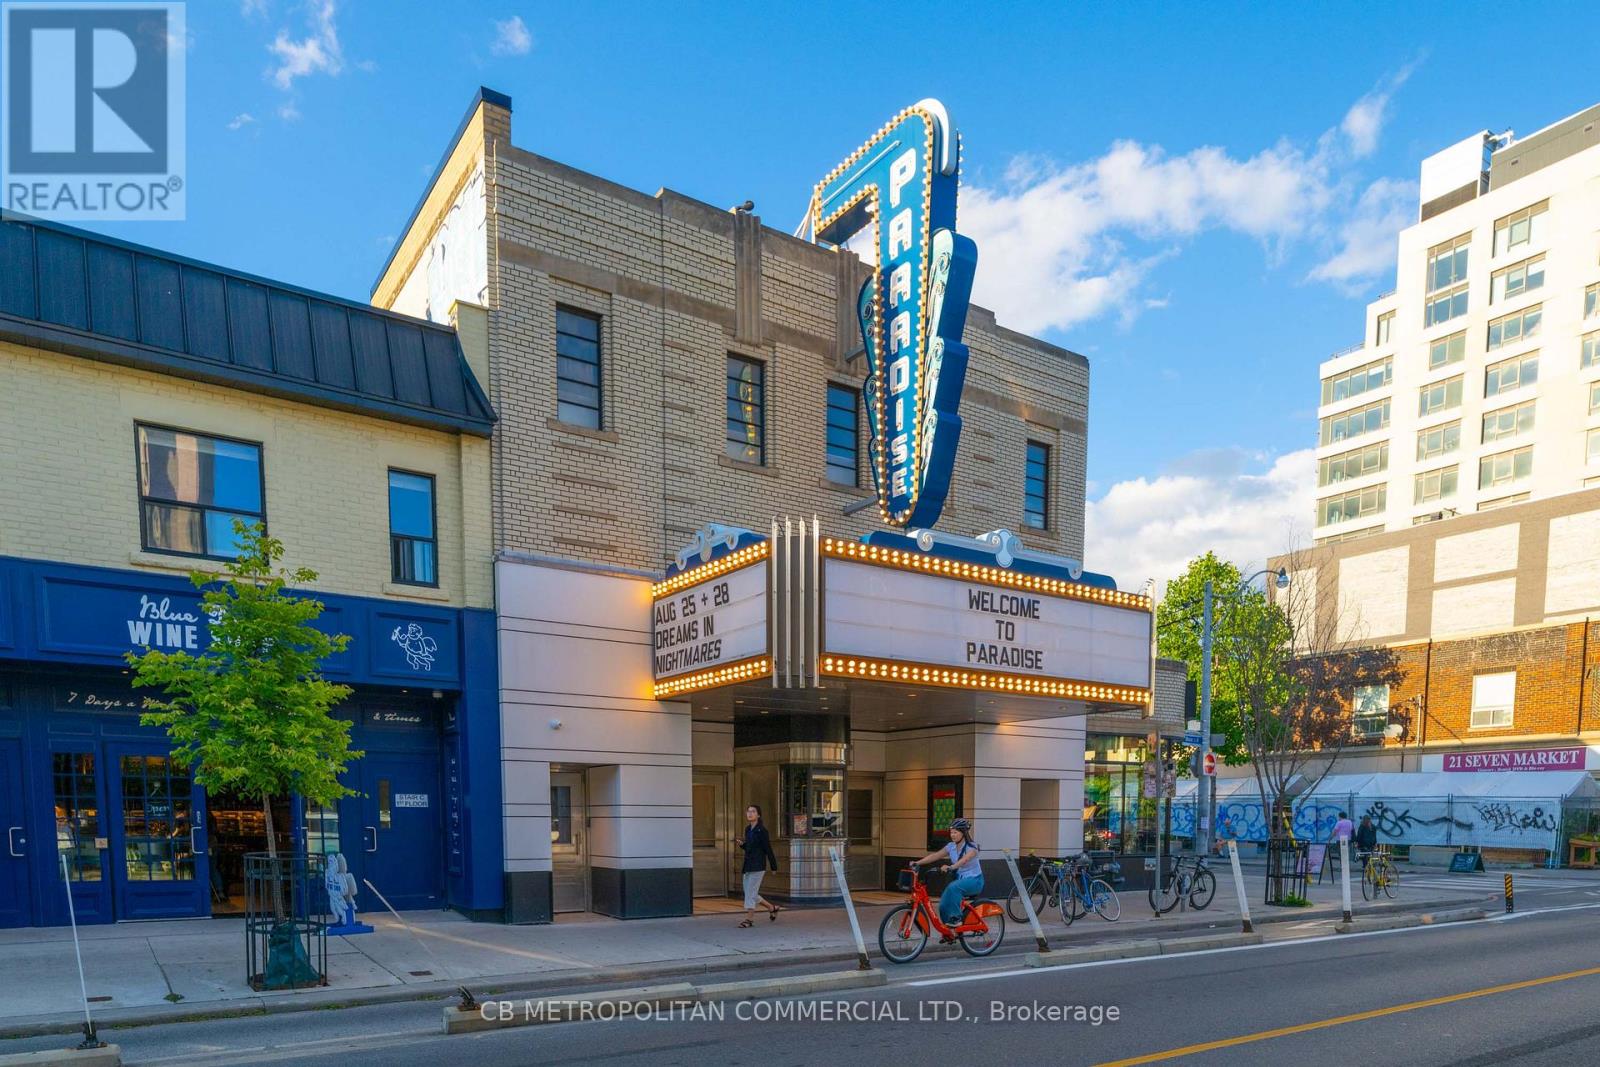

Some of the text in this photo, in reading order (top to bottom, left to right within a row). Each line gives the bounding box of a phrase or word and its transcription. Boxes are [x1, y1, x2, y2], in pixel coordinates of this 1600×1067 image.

[889, 148, 917, 498] PARADISE
[139, 594, 199, 623] Blue
[655, 582, 730, 626] AUG 25 + 28
[968, 588, 1040, 619] WELCOME
[127, 620, 198, 649] WINE
[655, 614, 714, 650] DREAMS IN
[995, 619, 1015, 641] TO
[655, 639, 722, 674] NIGHTMARES
[966, 641, 1043, 670] PARADISE
[68, 691, 78, 703] 7
[85, 694, 122, 710] Days
[1449, 750, 1579, 768] 21 SEVEN MARKET
